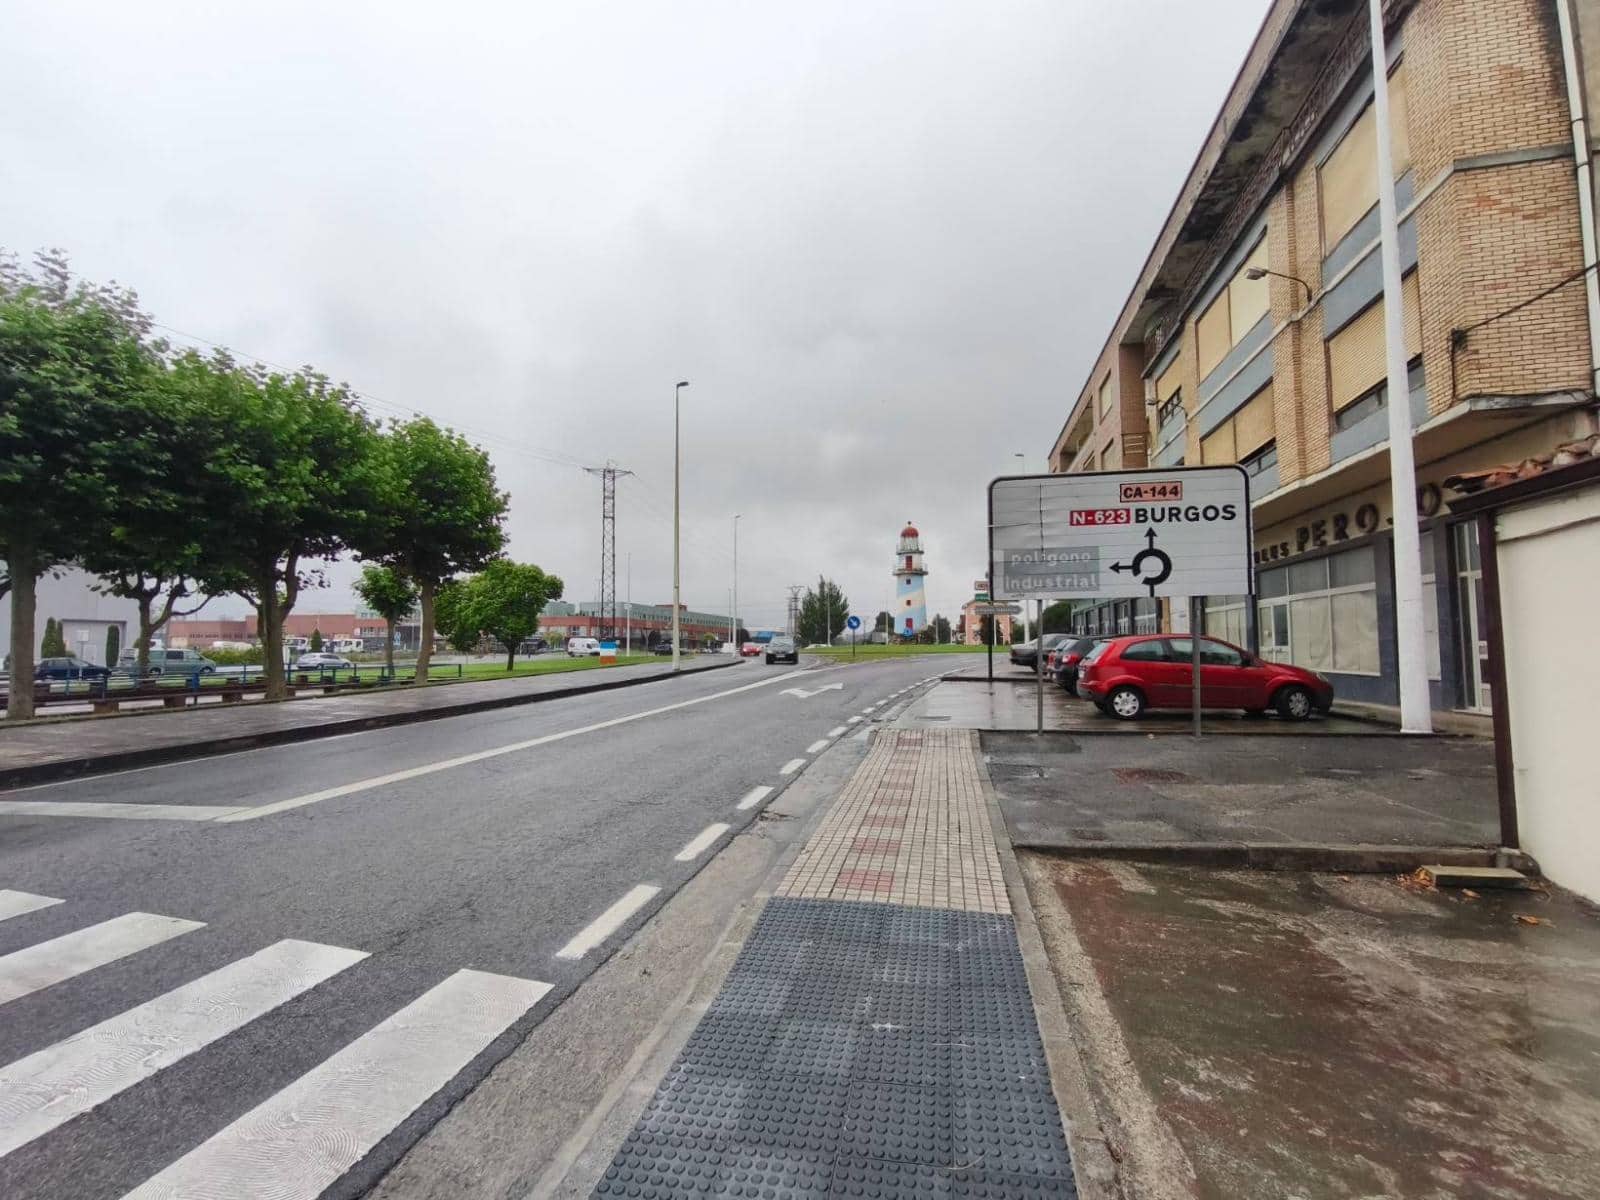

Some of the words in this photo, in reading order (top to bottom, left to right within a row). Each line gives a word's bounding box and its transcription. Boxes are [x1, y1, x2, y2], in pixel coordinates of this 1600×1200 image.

[1123, 485, 1179, 499] CA-144
[1072, 510, 1128, 525] N-623
[1135, 504, 1237, 524] BURGOS
[1296, 482, 1443, 553] PEROO
